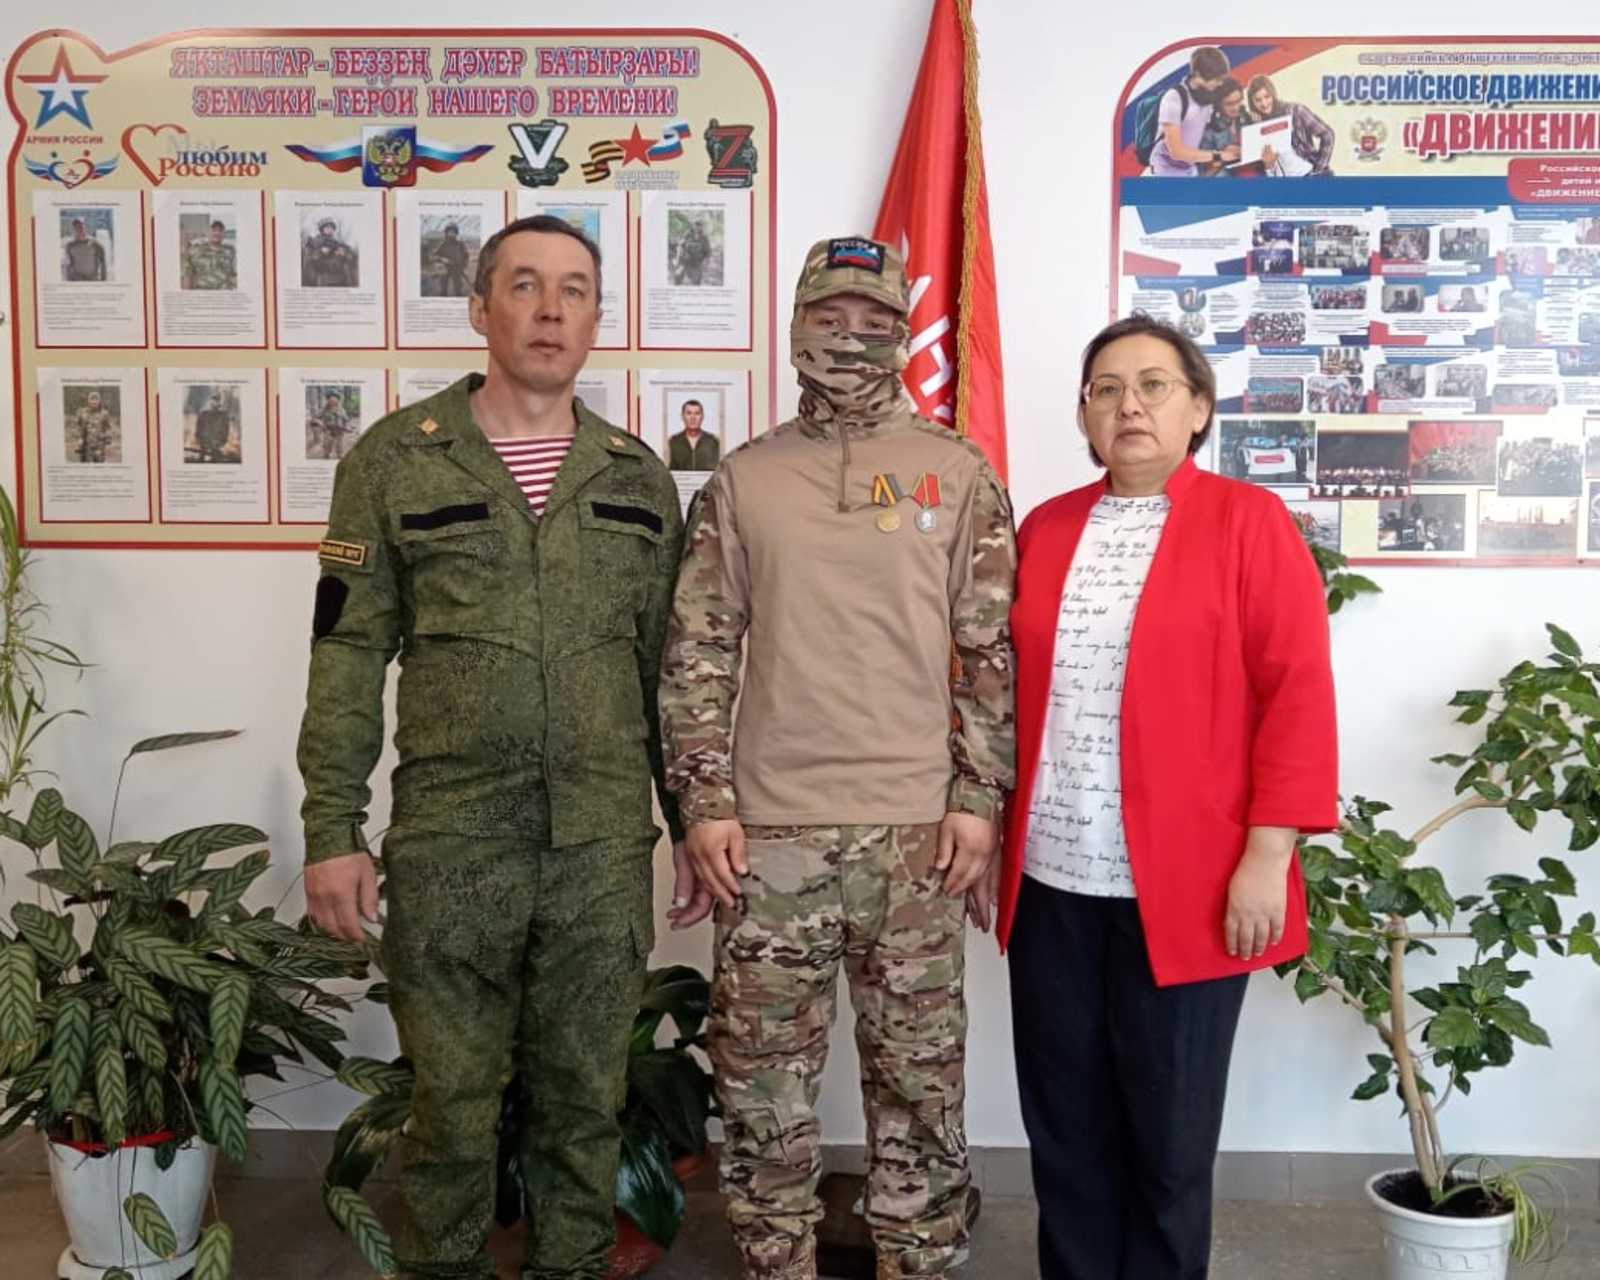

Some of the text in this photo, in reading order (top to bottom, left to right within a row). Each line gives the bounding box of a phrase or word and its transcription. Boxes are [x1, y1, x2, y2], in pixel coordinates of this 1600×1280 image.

[1321, 70, 1482, 101] РОССИЙСКОЕ
[195, 88, 314, 116] ЗЕМЛЯКИ
[335, 88, 416, 116] ГЕРОИ
[429, 88, 537, 116] НАШЕГО
[550, 88, 676, 116] ВРЕМЕНИ!
[1403, 113, 1600, 156] «ДВИЖЕНИ
